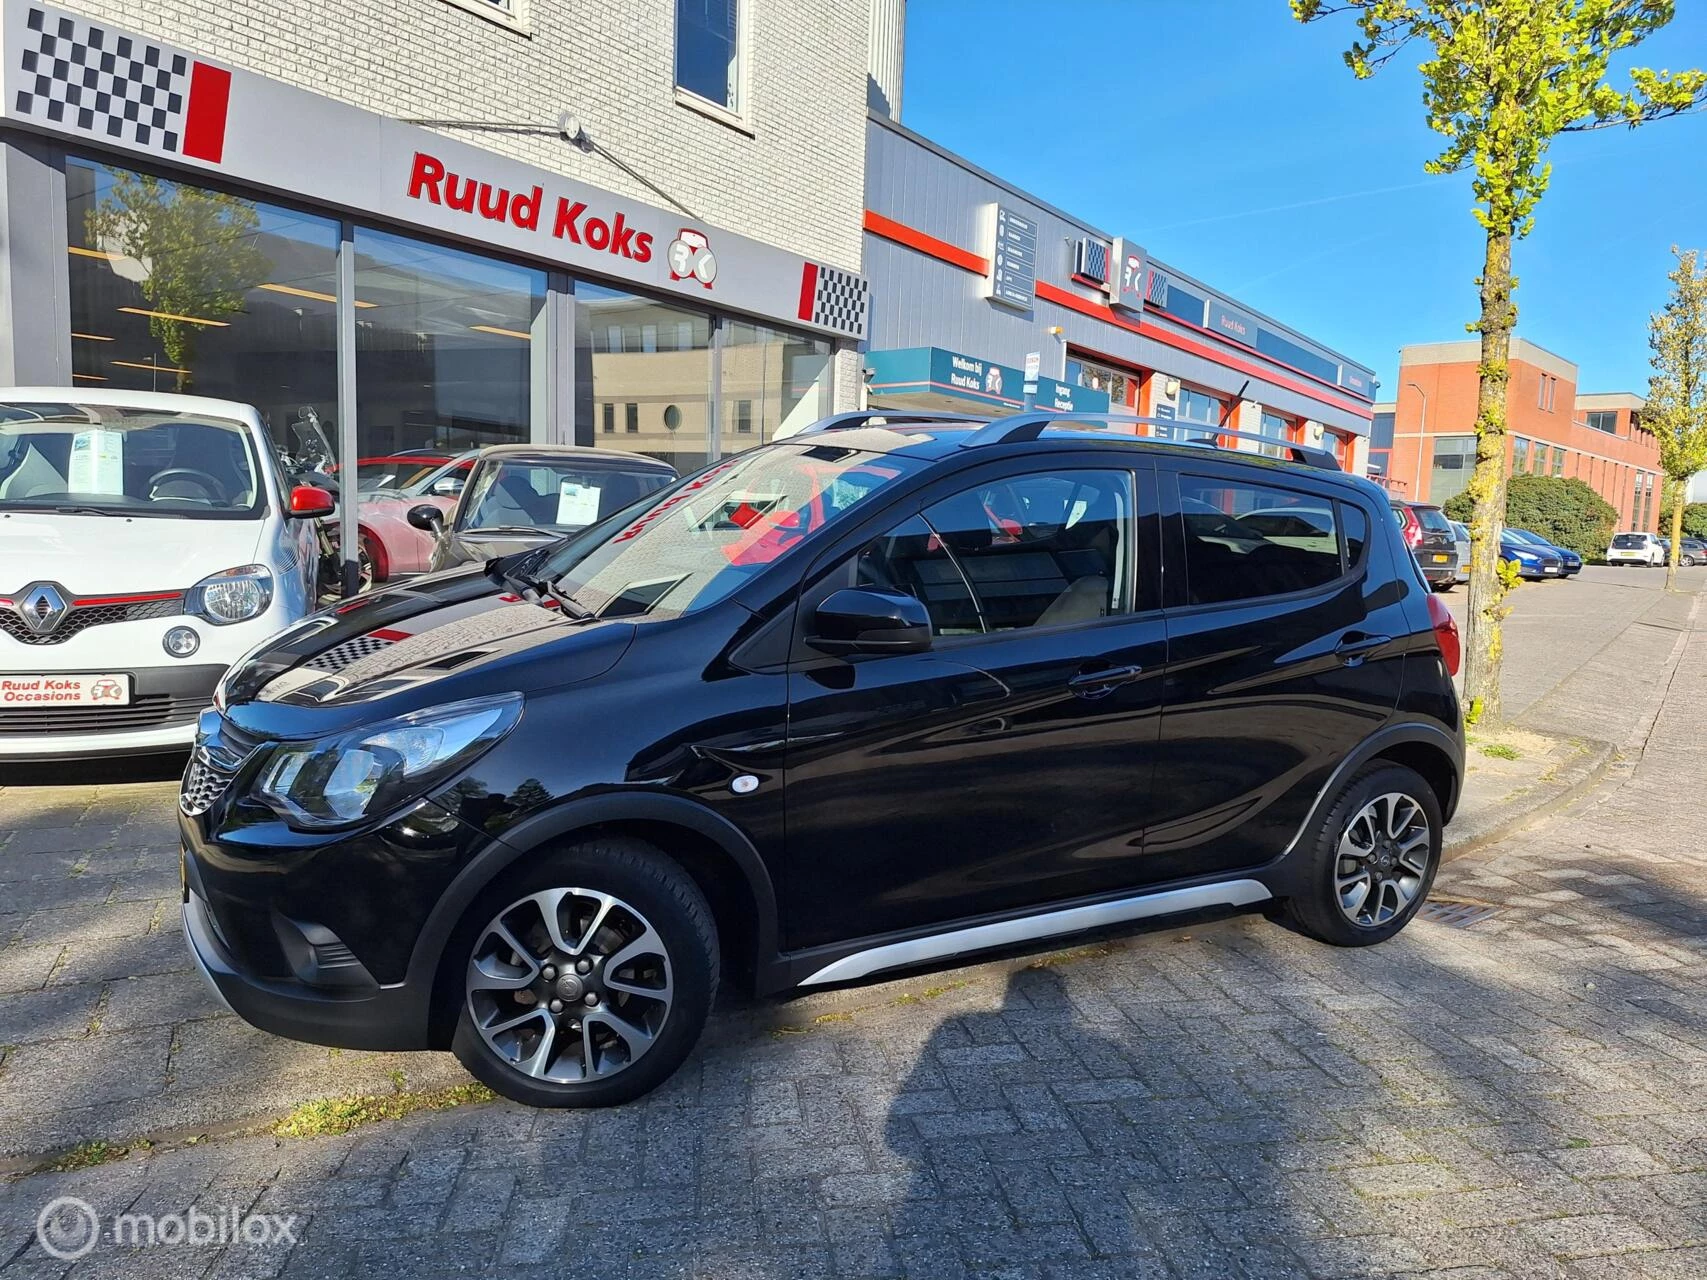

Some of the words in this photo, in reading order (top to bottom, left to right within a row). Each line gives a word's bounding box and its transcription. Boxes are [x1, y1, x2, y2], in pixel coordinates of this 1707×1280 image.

[406, 151, 544, 232] Ruud
[552, 196, 653, 263] Koks
[952, 355, 974, 372] Welkom
[974, 362, 983, 377] bij
[951, 372, 966, 387] Ruud
[966, 376, 980, 391] Koks
[1, 680, 40, 691] Ruud
[44, 680, 81, 690] Koks
[4, 691, 81, 702] Occasions
